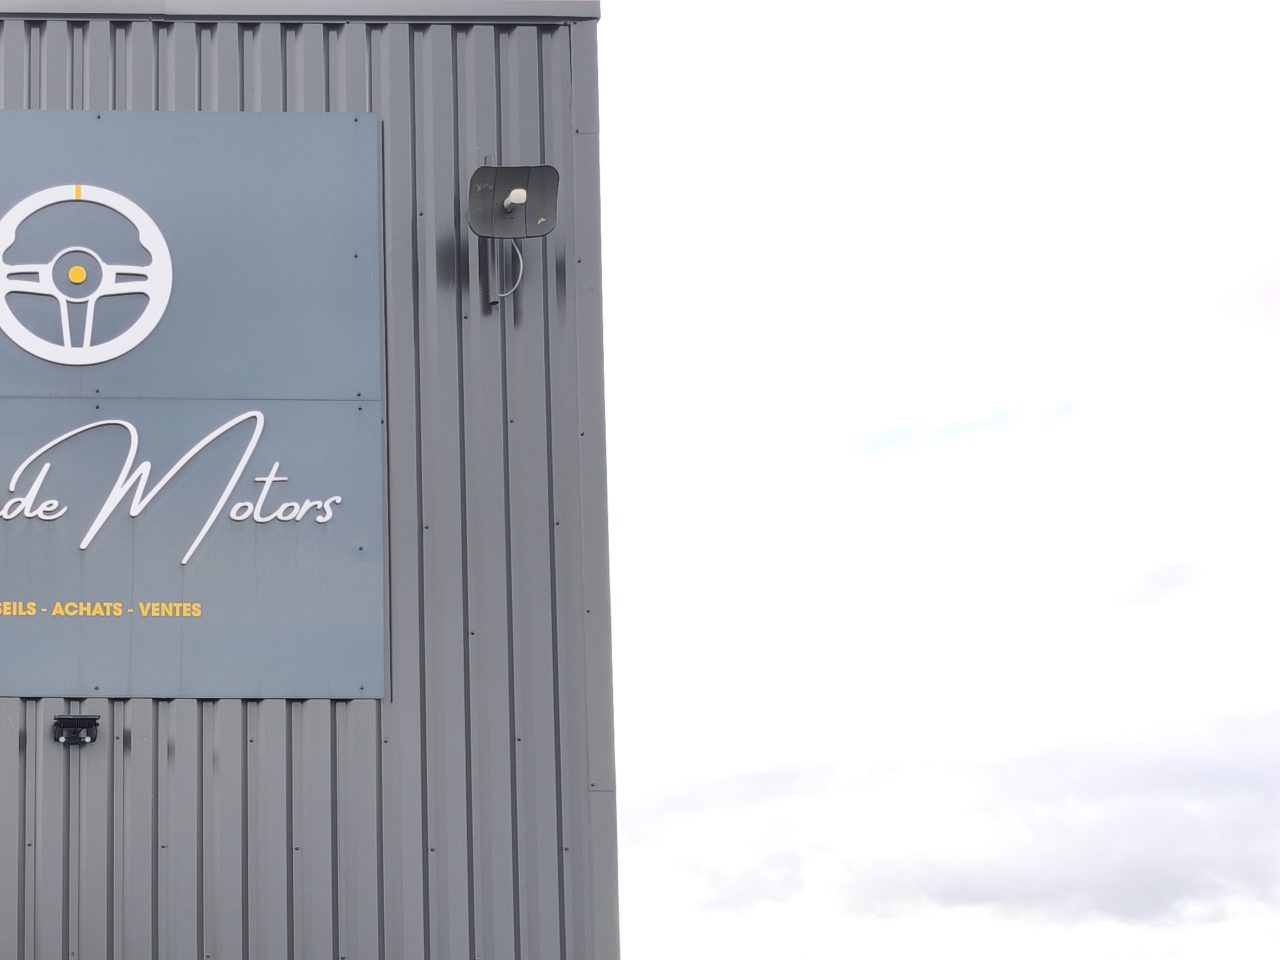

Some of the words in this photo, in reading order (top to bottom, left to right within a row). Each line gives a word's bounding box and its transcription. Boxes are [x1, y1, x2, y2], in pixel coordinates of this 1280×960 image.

[9, 410, 342, 566] Motors
[51, 601, 123, 617] ACHATS
[138, 602, 202, 617] VENTES
